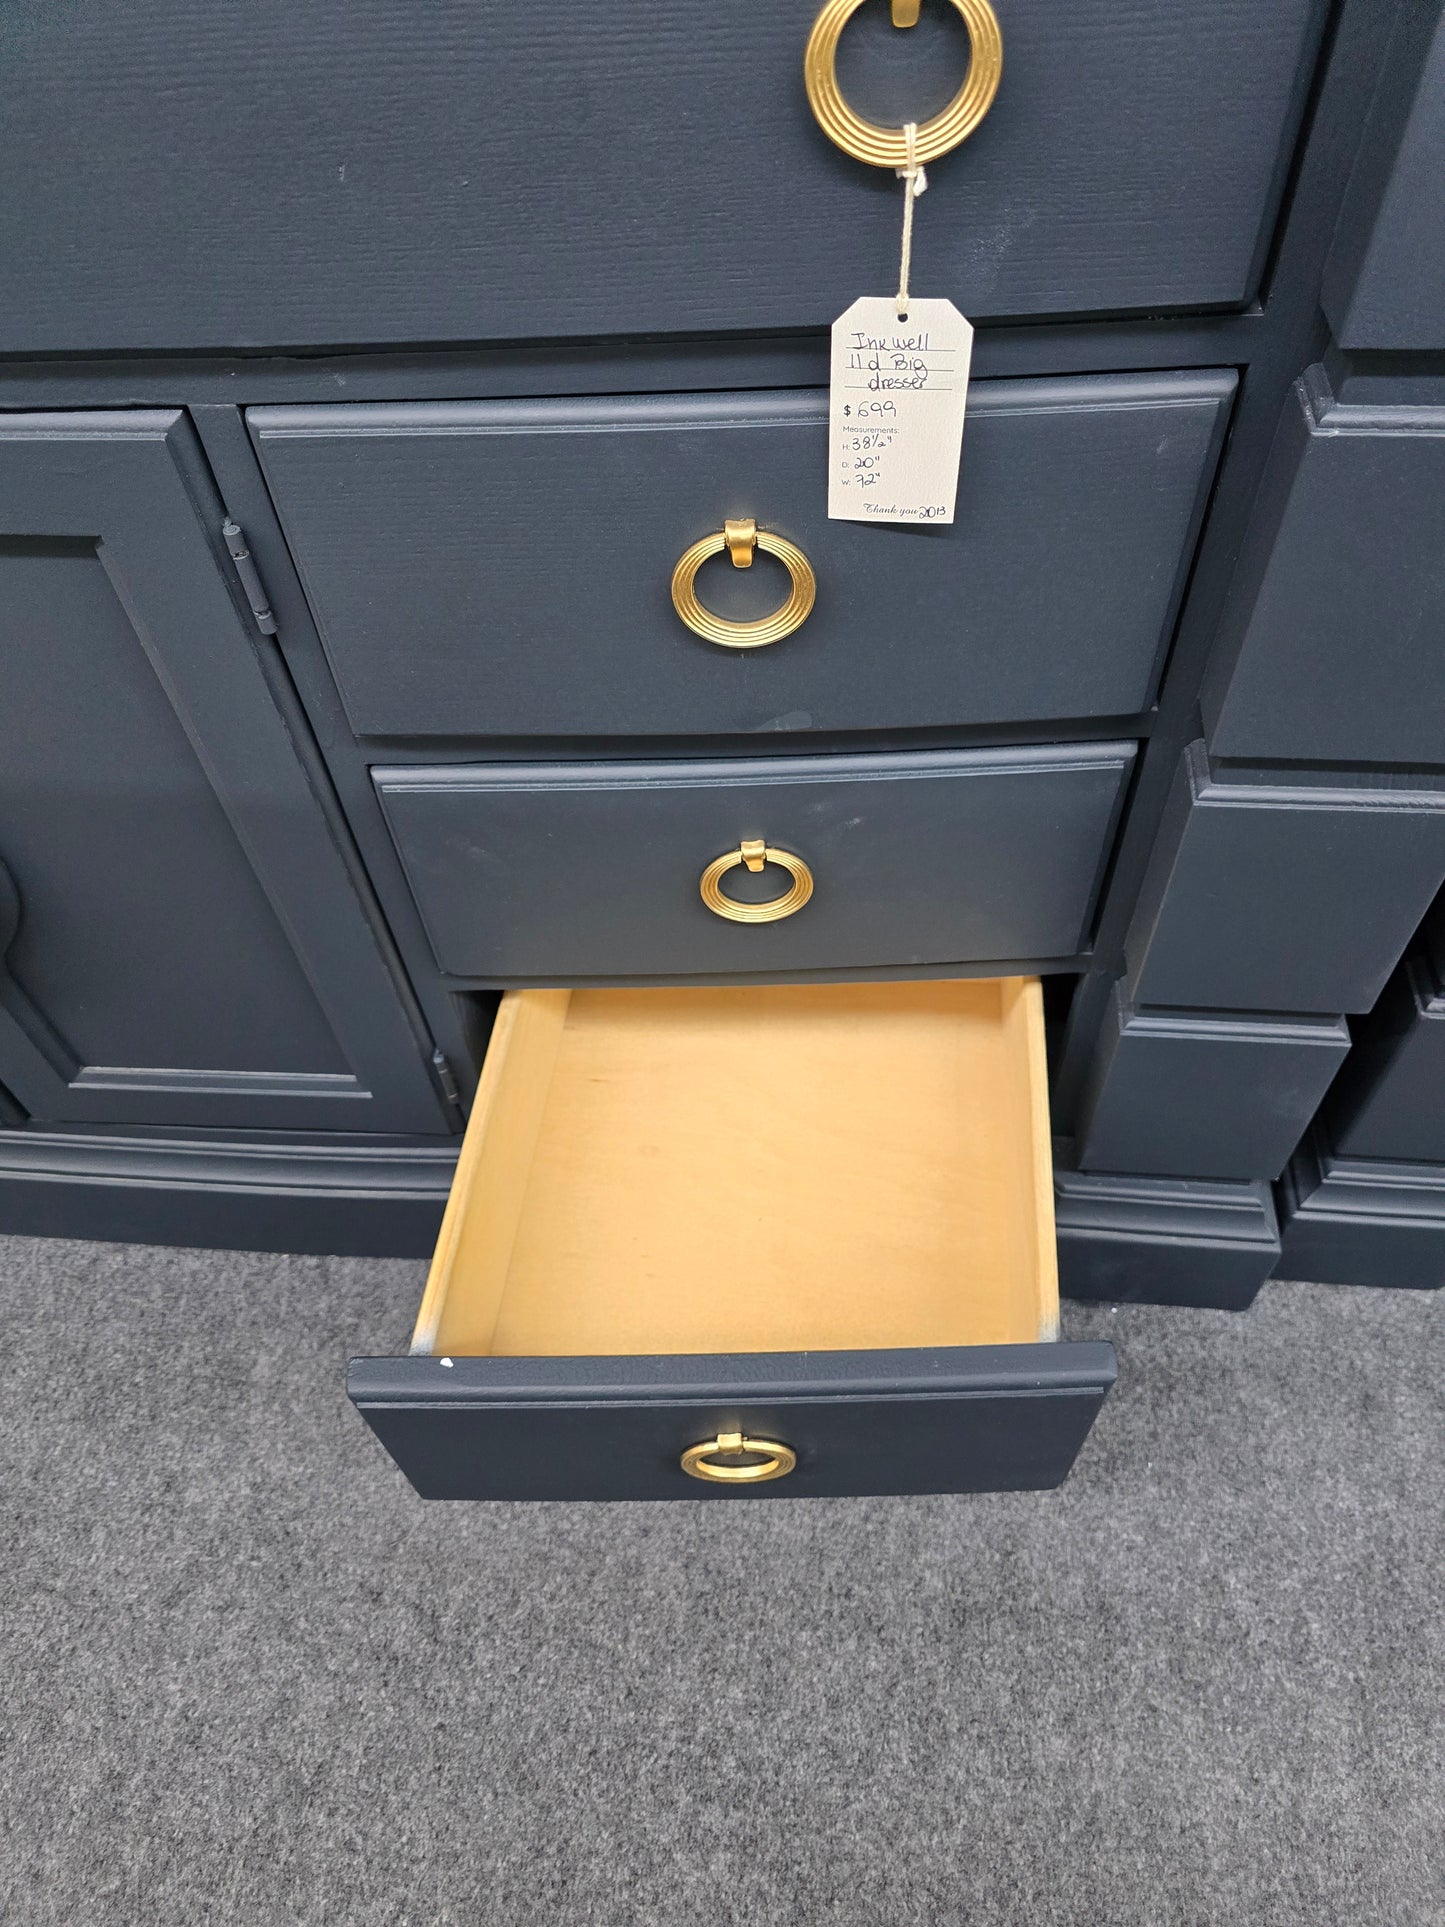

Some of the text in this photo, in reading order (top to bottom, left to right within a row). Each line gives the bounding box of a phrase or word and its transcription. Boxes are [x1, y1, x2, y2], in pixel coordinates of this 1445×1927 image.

[890, 354, 928, 379] Big
[868, 372, 927, 392] dresser
[857, 401, 896, 417] 699
[842, 426, 900, 434] Measurements:
[863, 503, 899, 514] Thank
[899, 508, 919, 517] you
